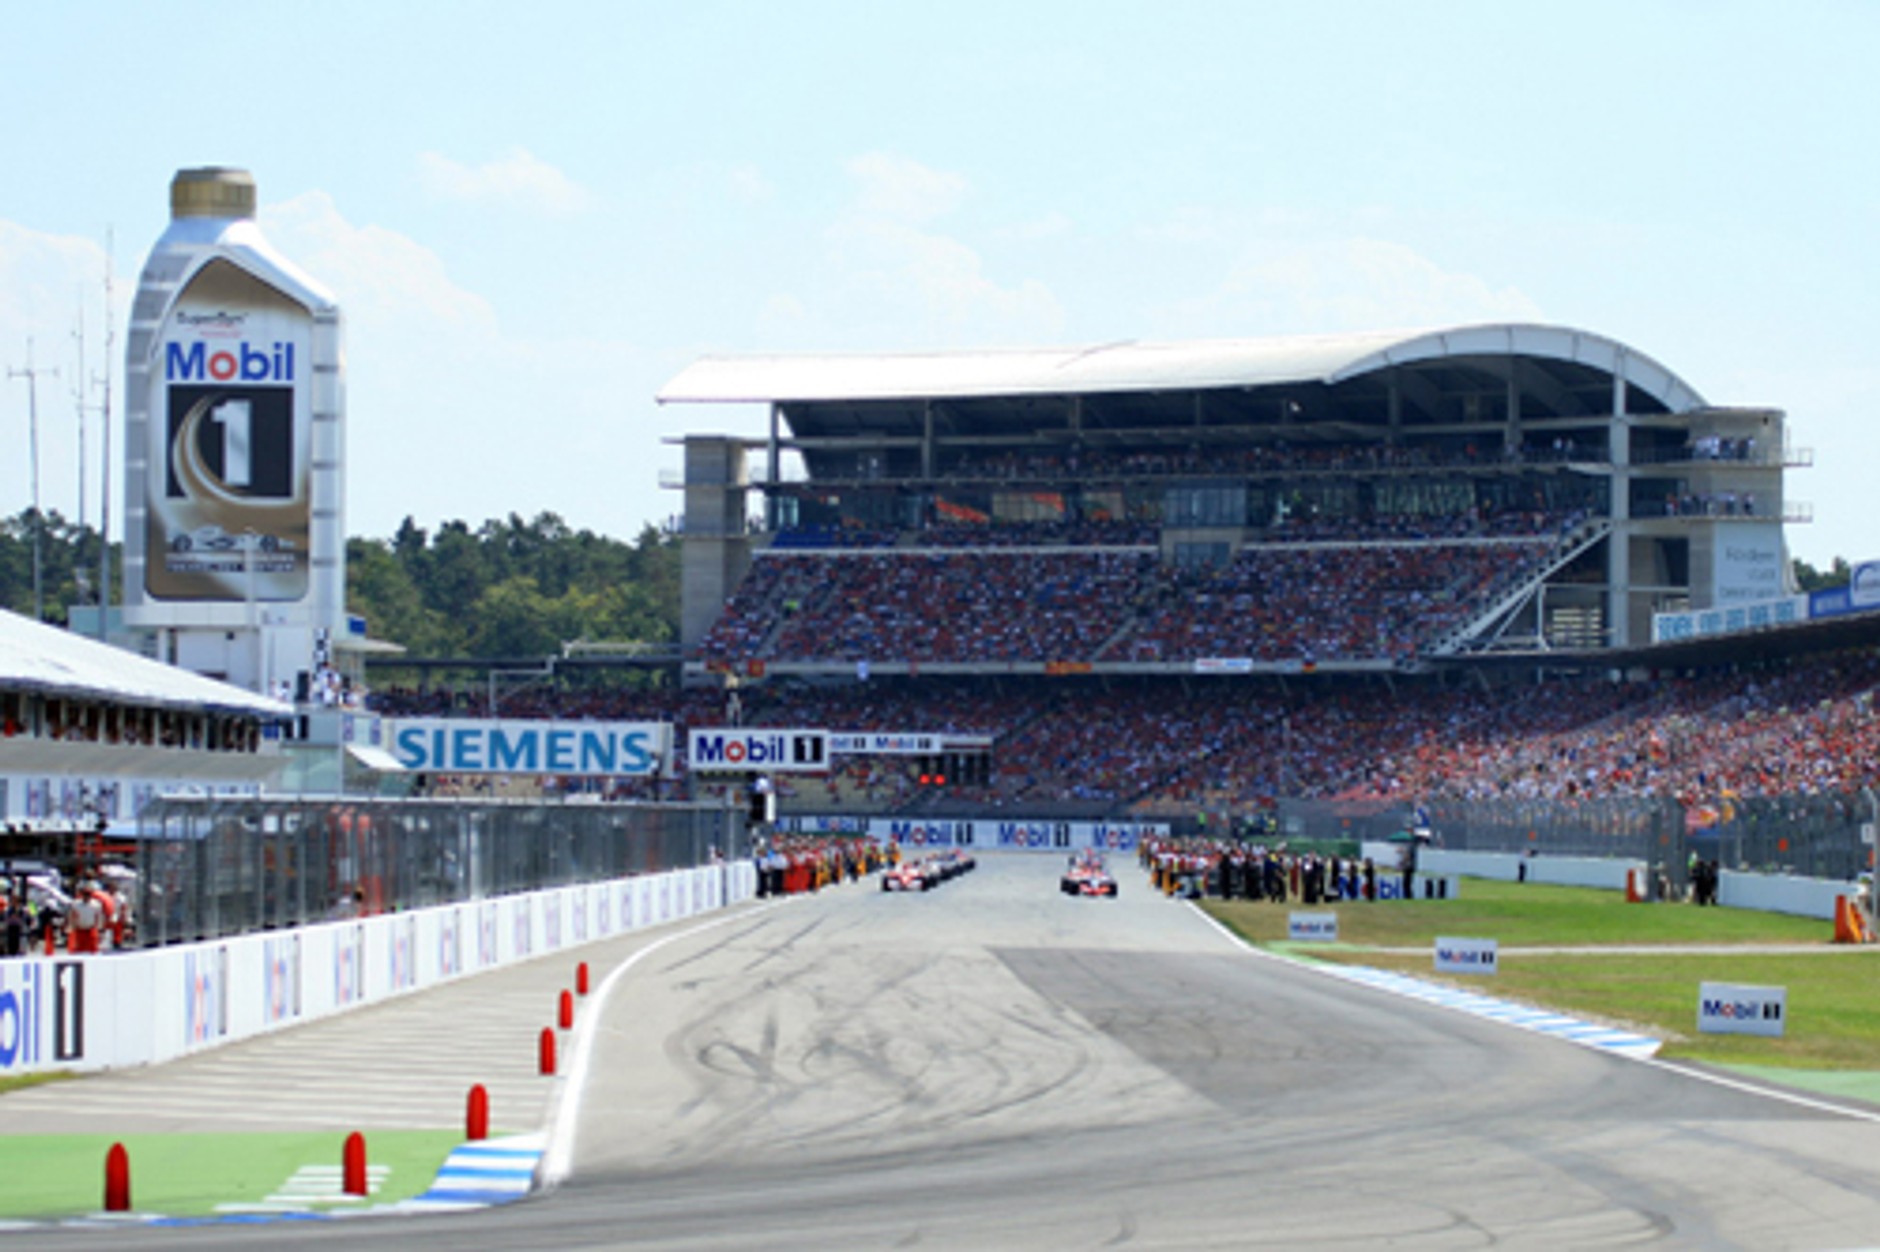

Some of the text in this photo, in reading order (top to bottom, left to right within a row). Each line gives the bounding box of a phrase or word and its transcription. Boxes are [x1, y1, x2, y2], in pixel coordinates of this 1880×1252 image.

[166, 342, 294, 381] Mobil
[211, 400, 251, 486] 1
[397, 728, 652, 772] SIEMENS
[696, 736, 784, 762] Mobil
[891, 822, 951, 844] Mobil
[1000, 822, 1049, 847] Mobil
[1094, 824, 1140, 850] Mobil
[1439, 949, 1478, 963] Mobil
[1703, 999, 1758, 1019] Mobil
